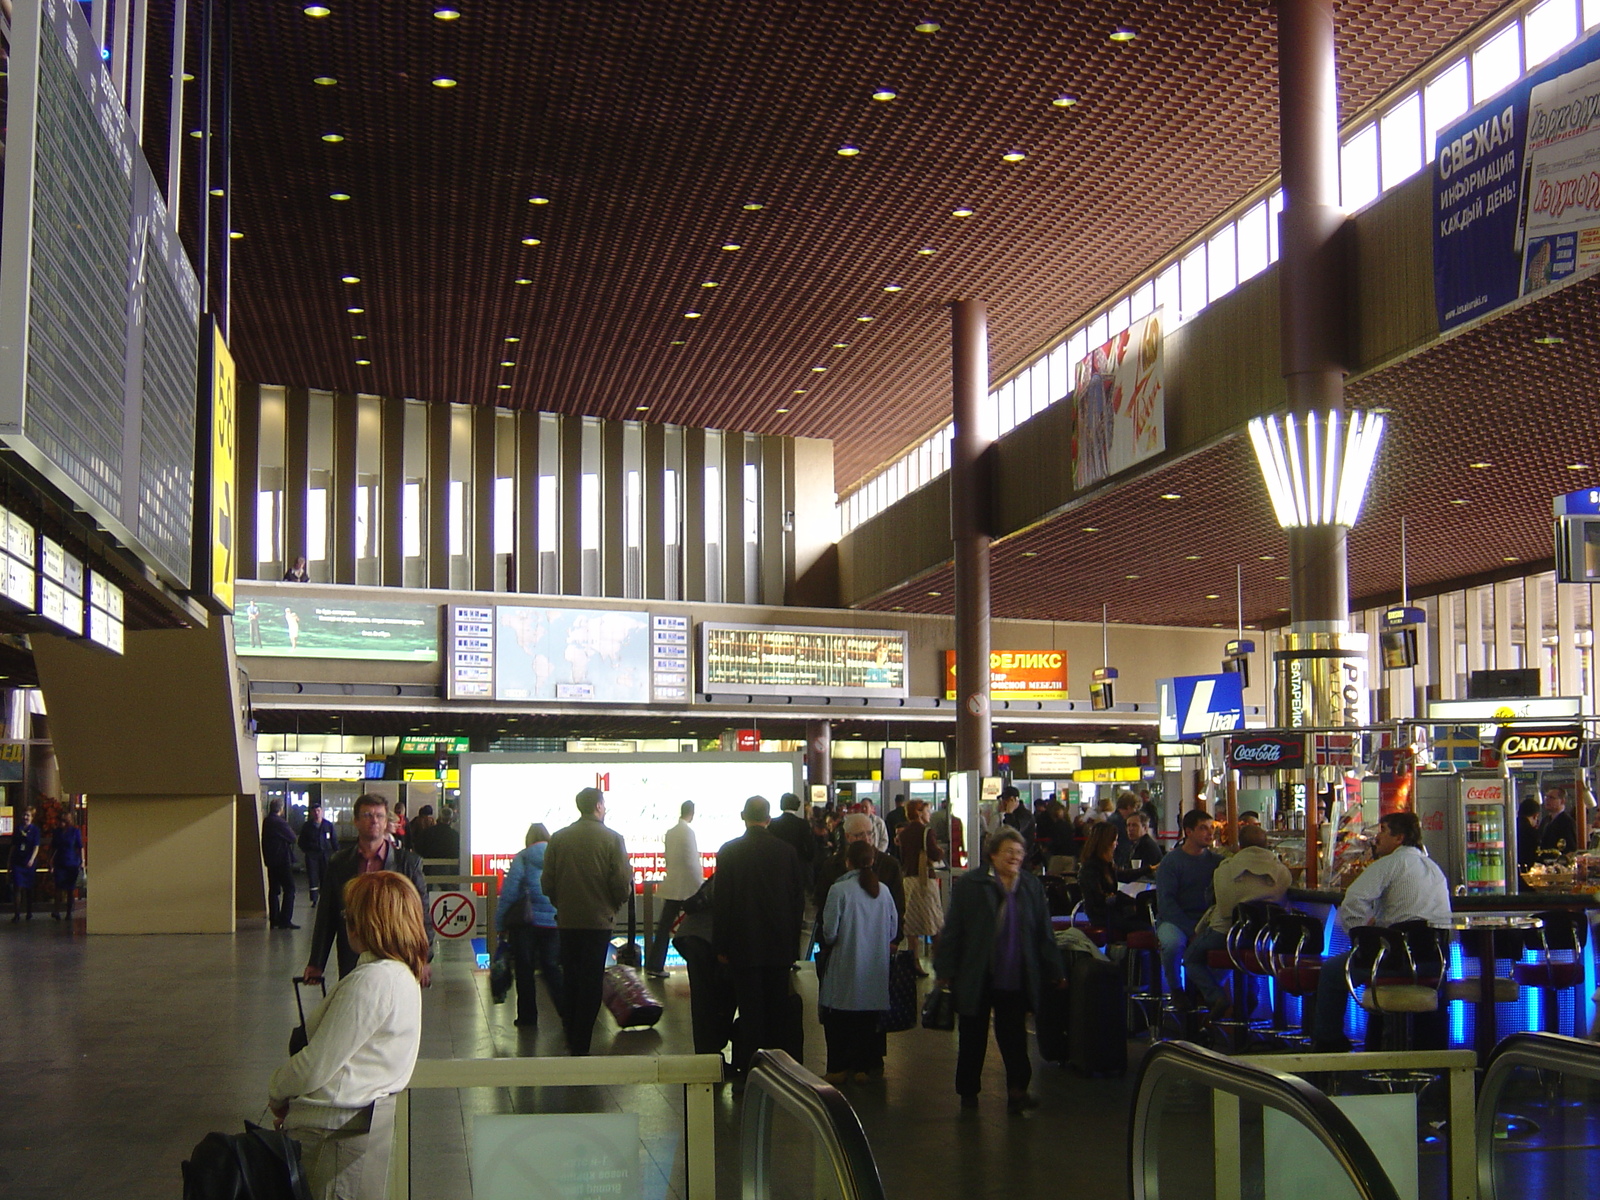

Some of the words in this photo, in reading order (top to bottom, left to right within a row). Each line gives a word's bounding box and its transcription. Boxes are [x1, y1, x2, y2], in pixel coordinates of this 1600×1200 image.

[1440, 105, 1514, 181] СВЕЖАЯ
[1440, 149, 1515, 210] ИНФОРМАЦИЯ
[1440, 197, 1482, 238] КАЖДЫЙ
[1486, 181, 1516, 217] ДЕНЬ!
[1234, 744, 1280, 761] Coca-Cola
[1501, 736, 1579, 755] CARLING
[406, 772, 414, 782] 7
[1466, 786, 1503, 800] Coca-Cola
